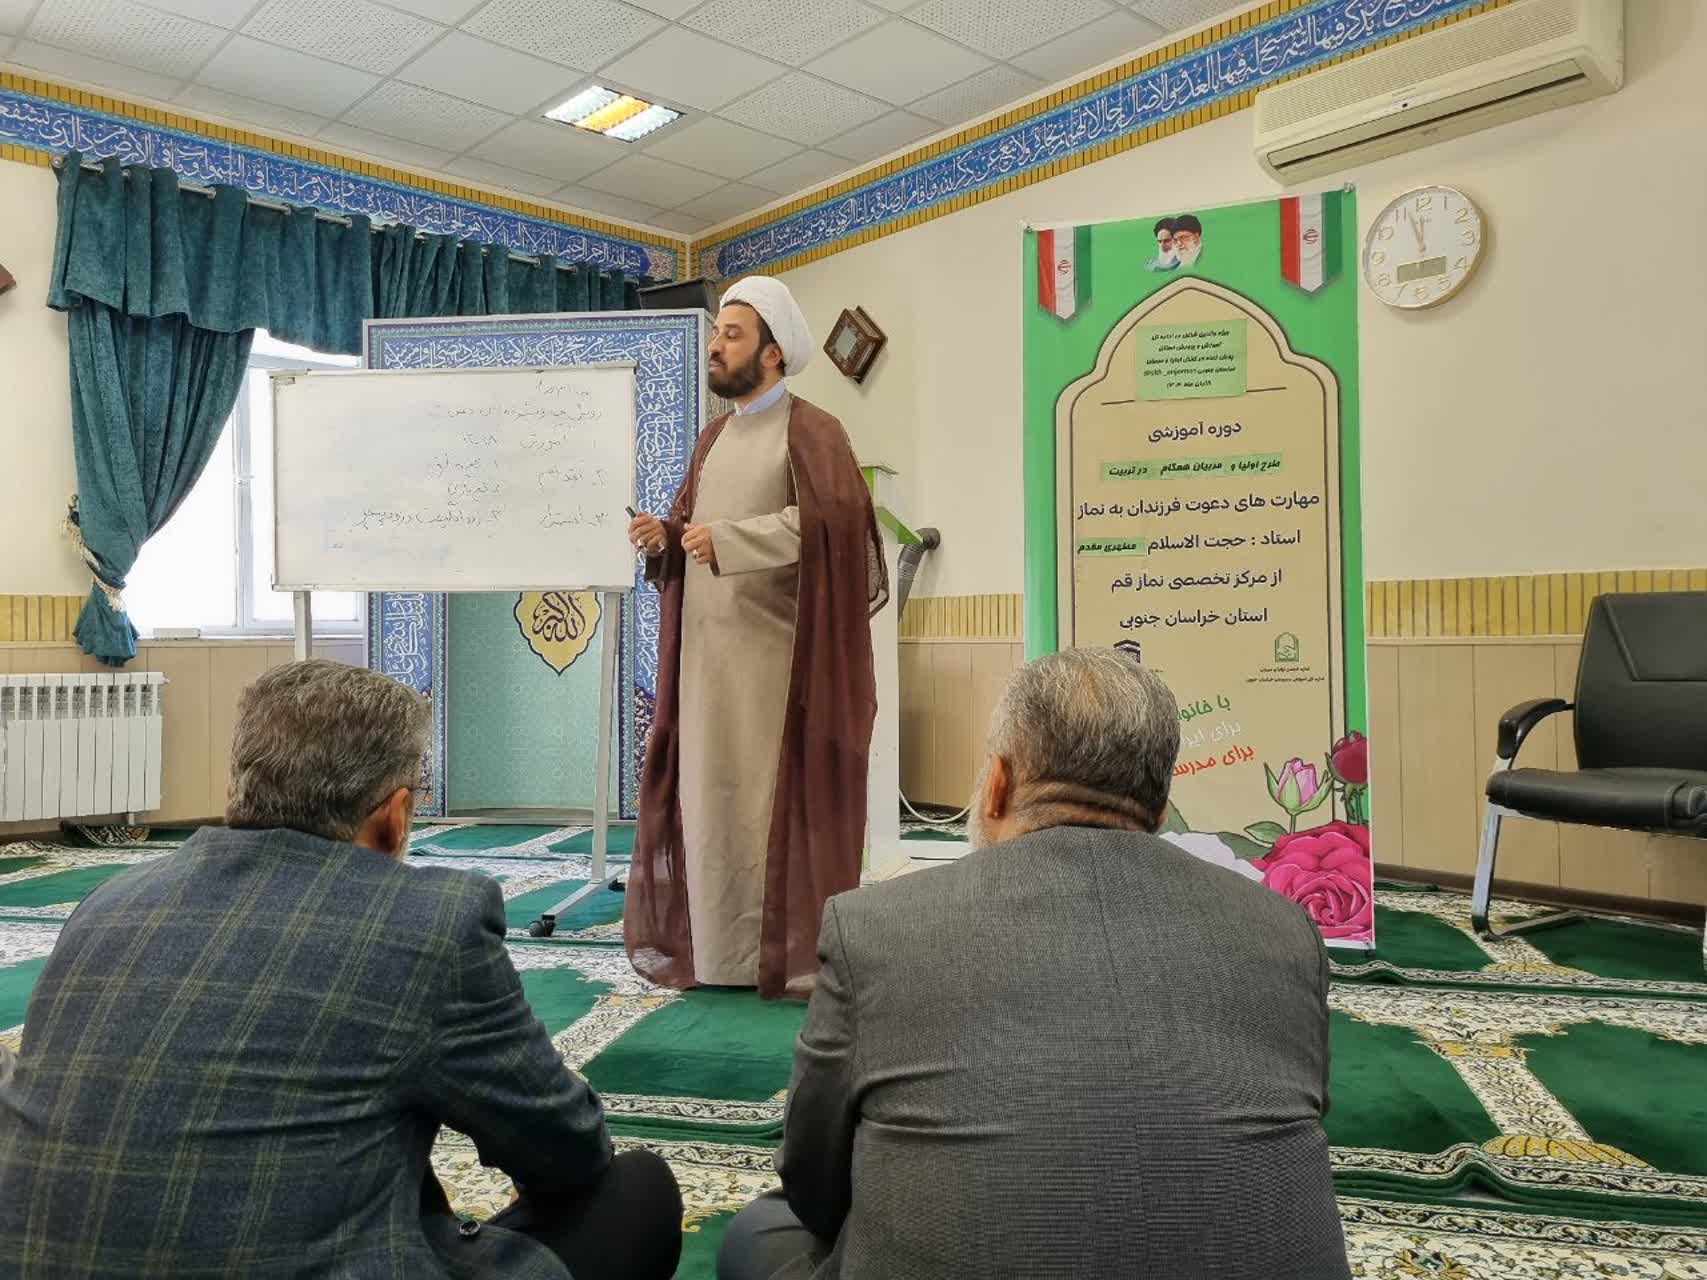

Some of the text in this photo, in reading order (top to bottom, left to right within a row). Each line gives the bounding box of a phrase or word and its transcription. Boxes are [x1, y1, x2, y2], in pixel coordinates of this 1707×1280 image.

[1148, 420, 1242, 442] دوره آموزشی
[1109, 465, 1136, 477] تربیت
[1193, 461, 1222, 472] مربیان
[1231, 463, 1236, 472] و
[1239, 460, 1259, 471] اولیا
[1077, 491, 1320, 520] مهارت های دعوت فرزندان به نماز
[1147, 534, 1199, 556] الاسلام
[1204, 536, 1246, 550] حجت
[1260, 529, 1301, 545] استاد
[1111, 568, 1282, 593] از مرکز تخصصی نماز قم
[1120, 608, 1267, 631] استان خراسان جنوبی
[1177, 695, 1231, 722] با خانوا
[1172, 745, 1254, 776] برای مدرس
